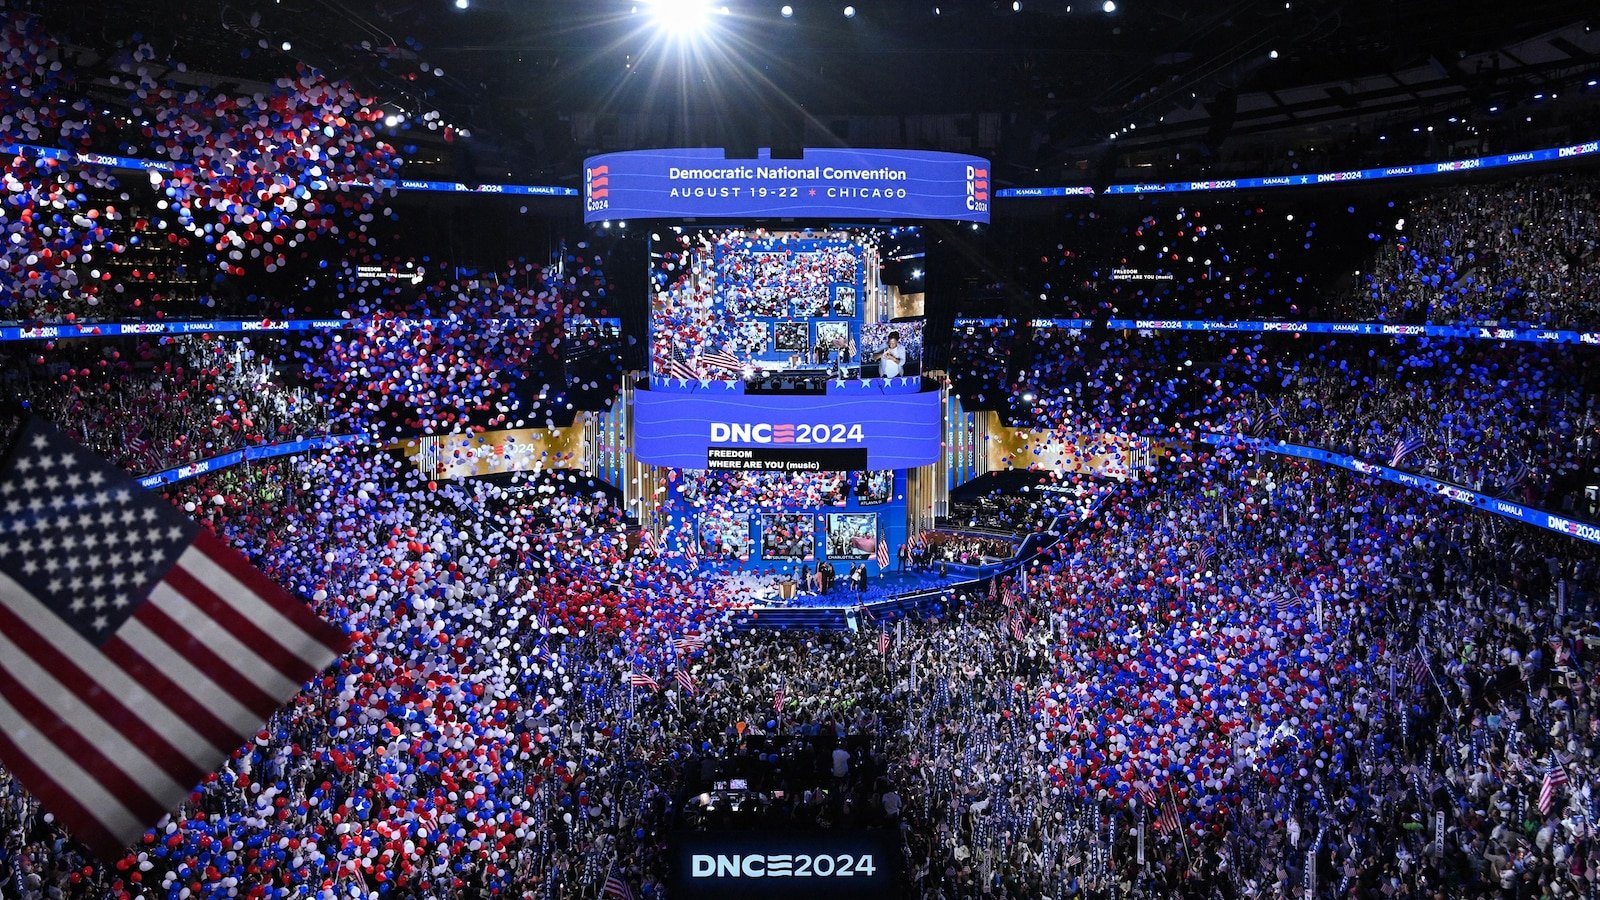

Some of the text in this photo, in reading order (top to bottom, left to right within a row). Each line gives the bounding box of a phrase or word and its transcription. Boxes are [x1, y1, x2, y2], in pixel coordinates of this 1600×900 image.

[1581, 143, 1598, 153] 2024
[1508, 153, 1534, 162] KAMALA
[1460, 159, 1480, 169] 2024
[670, 166, 906, 180] Democratic National Convention
[1342, 171, 1362, 179] 2024
[1215, 180, 1236, 188] 2024
[670, 188, 907, 198] AUGUST 19-22 CHICAGO
[796, 424, 864, 443] 2024
[708, 450, 752, 458] FREEDOM
[708, 460, 820, 471] WHERE ARE YOU (music)
[1498, 502, 1523, 517] KAMALA
[1576, 522, 1600, 541] 2024
[795, 854, 876, 877] 2024
